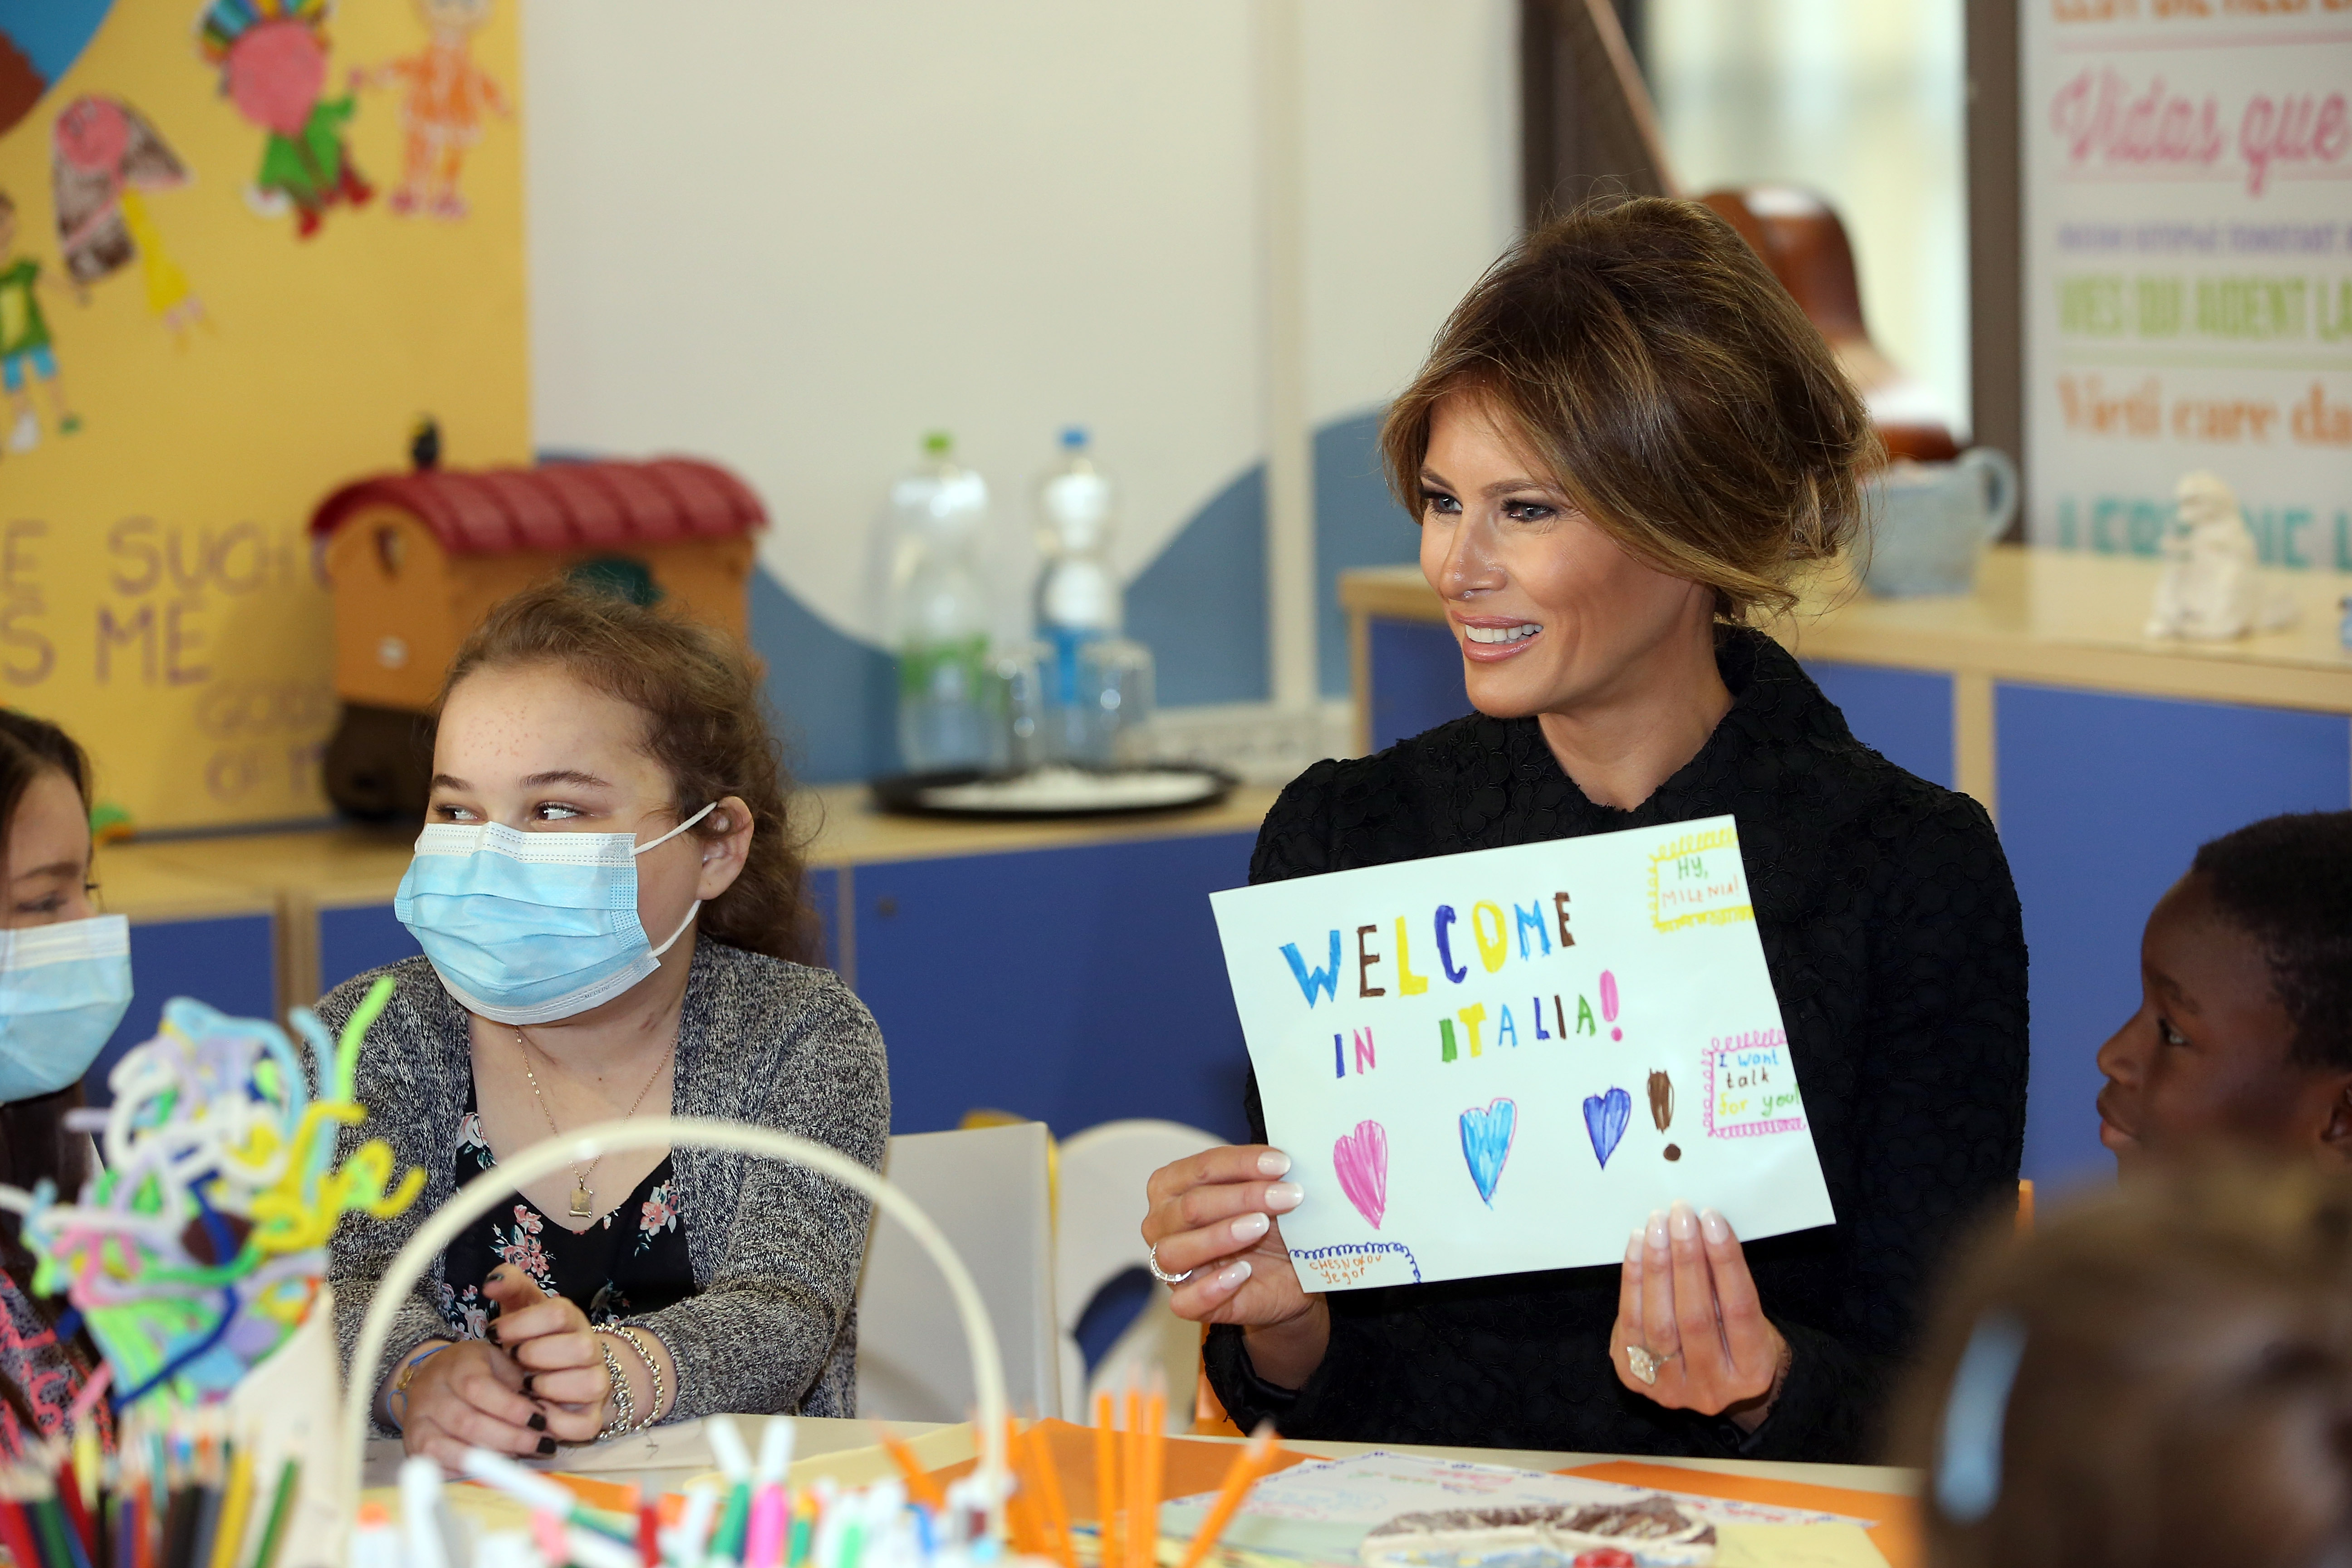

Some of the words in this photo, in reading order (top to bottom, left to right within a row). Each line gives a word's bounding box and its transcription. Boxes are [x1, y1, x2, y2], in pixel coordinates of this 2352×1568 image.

[2239, 93, 2351, 197] que
[97, 600, 211, 684] ME
[1279, 891, 1577, 1009] WELCOME
[1333, 1025, 1376, 1079] IN
[1438, 969, 1624, 1063] ITALIA!
[1719, 1053, 1728, 1068] I
[1718, 1092, 1749, 1116] for
[1727, 1066, 1769, 1089] talk
